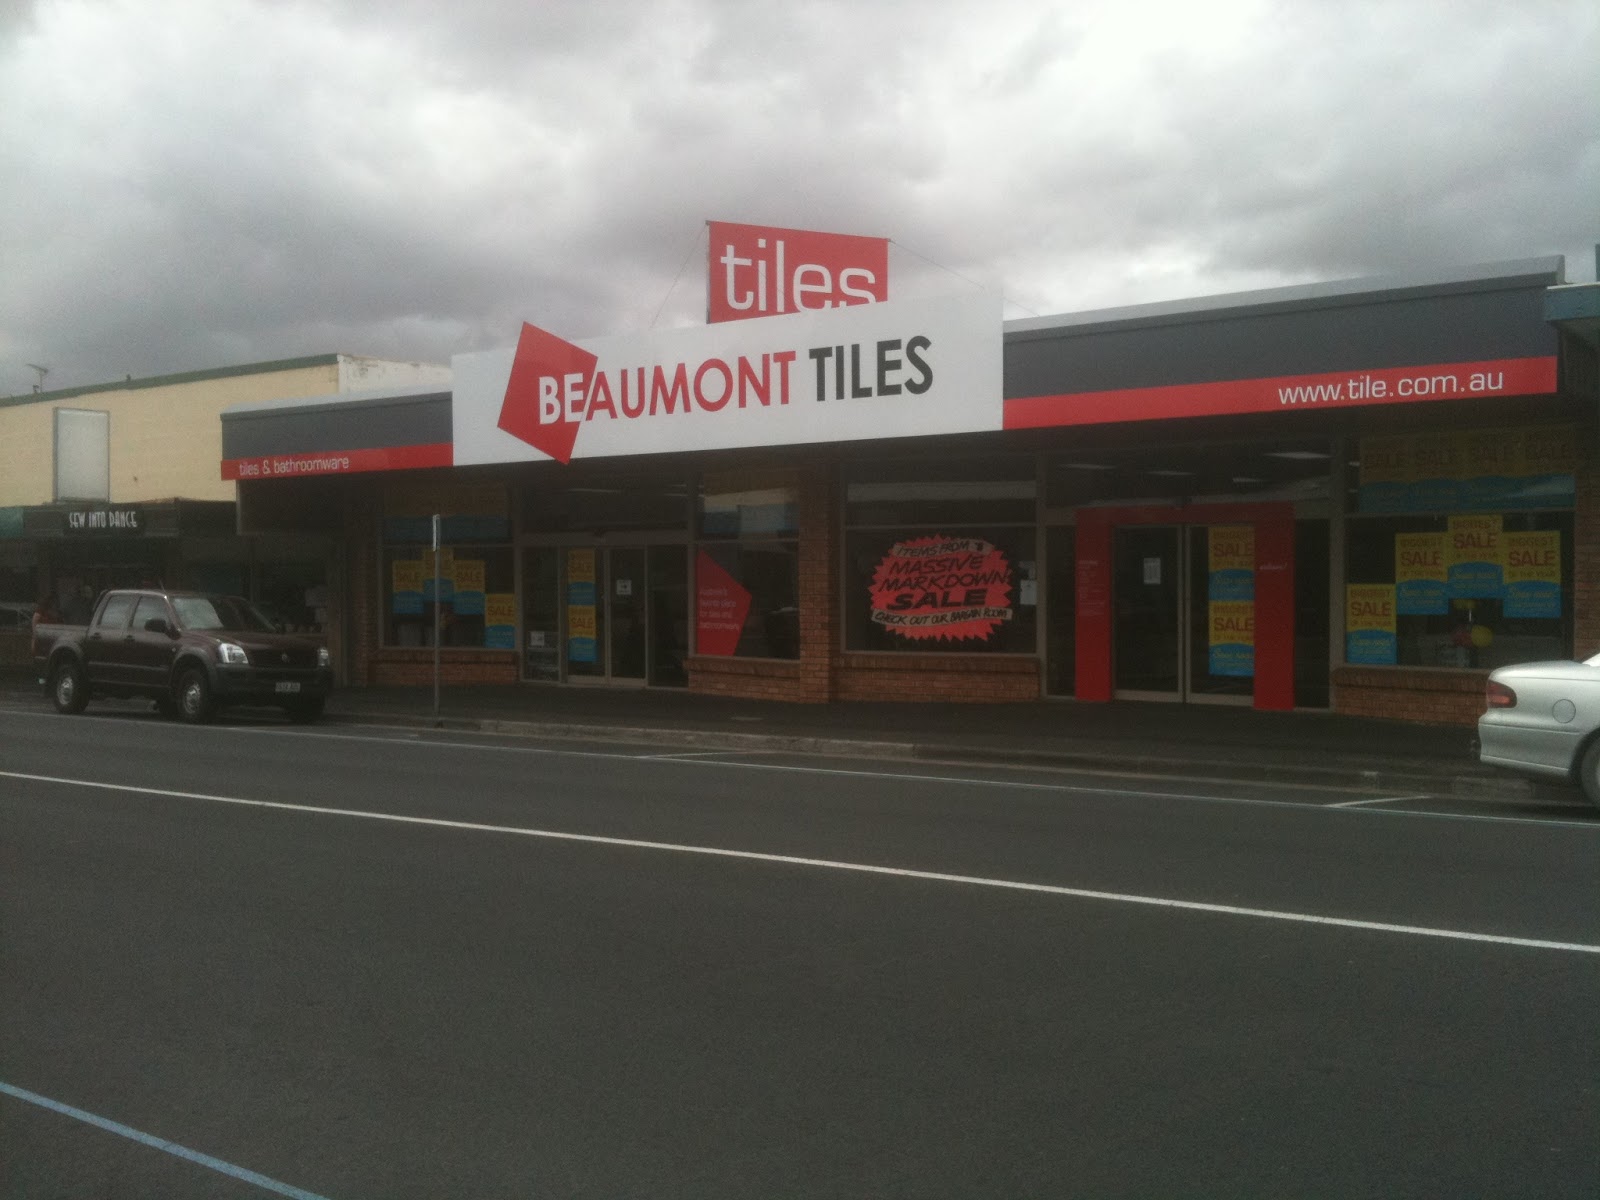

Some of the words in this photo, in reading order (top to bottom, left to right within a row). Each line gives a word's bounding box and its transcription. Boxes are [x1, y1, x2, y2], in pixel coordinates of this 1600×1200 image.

[720, 239, 876, 312] tiles
[538, 350, 796, 425] BEAUMONT
[809, 335, 934, 402] TILES
[1278, 371, 1504, 404] www.tile.com.au
[239, 461, 259, 476] tiles
[263, 459, 271, 474] &
[273, 457, 350, 474] bathroomware
[69, 511, 86, 528] SEW
[88, 511, 106, 528] INTO
[108, 511, 138, 528] DANCE
[897, 544, 940, 557] ITEMS
[939, 539, 970, 553] FROM
[1453, 532, 1498, 549] SALE
[1213, 543, 1254, 558] SALE
[1399, 550, 1443, 567] SALE
[1508, 549, 1556, 567] SALE
[889, 554, 984, 575] MASSIVE
[877, 567, 1008, 592] MARKDOWN
[886, 588, 988, 611] SALE
[487, 605, 514, 617] SALE
[874, 611, 908, 625] CHECK
[909, 614, 930, 625] OUT
[931, 614, 950, 625] OUR
[950, 609, 981, 622] BARGAIN
[1350, 601, 1392, 617] SALE
[1213, 617, 1255, 632] SALE
